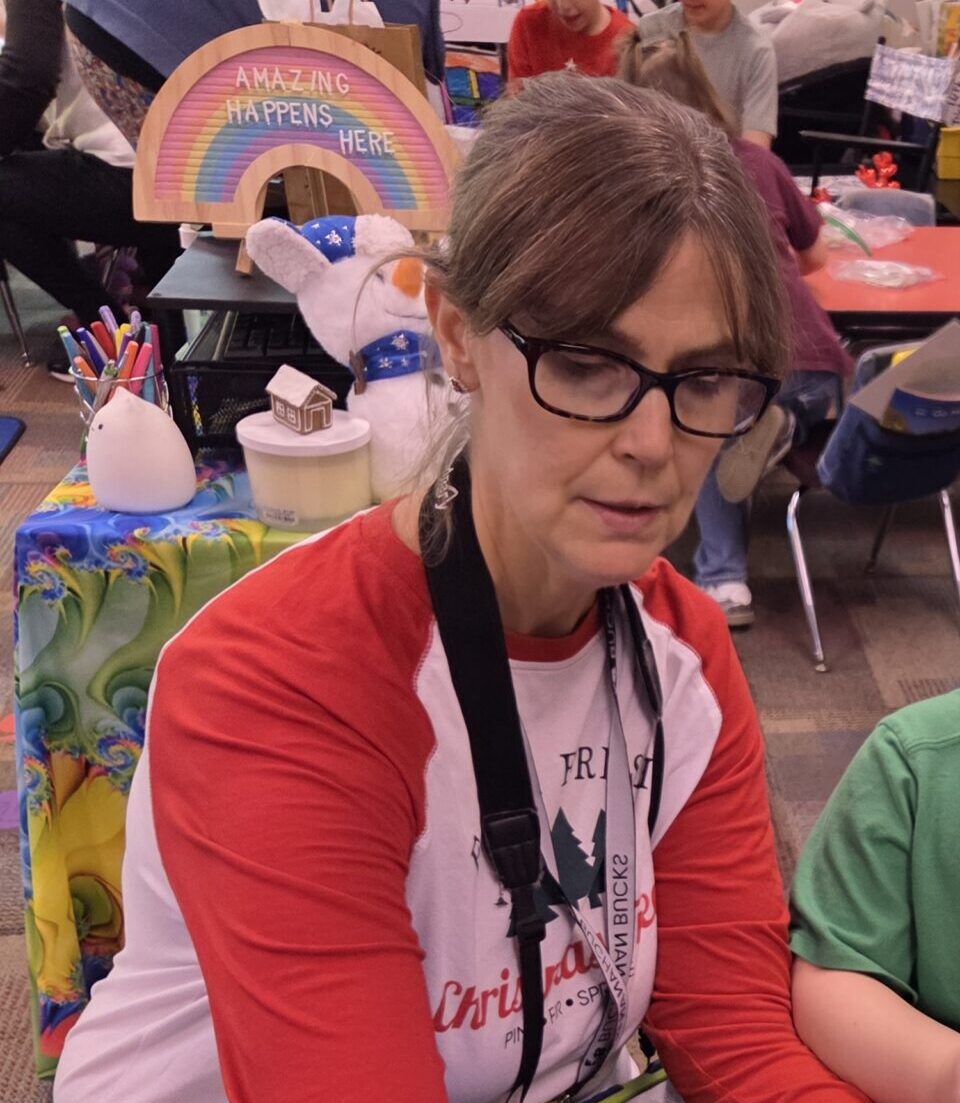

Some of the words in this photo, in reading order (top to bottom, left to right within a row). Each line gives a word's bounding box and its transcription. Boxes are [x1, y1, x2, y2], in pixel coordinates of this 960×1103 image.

[236, 66, 350, 95] AMAZING
[226, 100, 333, 127] HAPPENS
[339, 129, 395, 155] HERE
